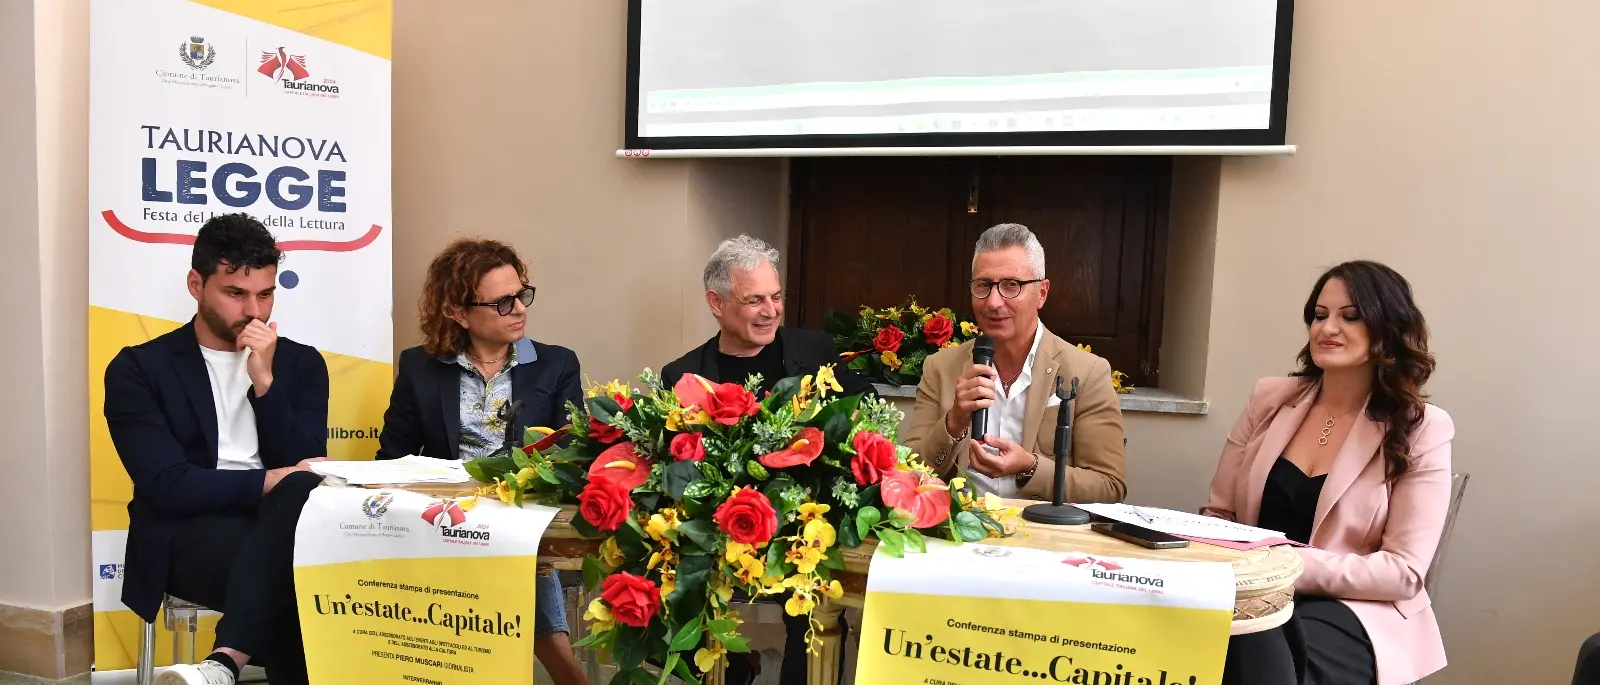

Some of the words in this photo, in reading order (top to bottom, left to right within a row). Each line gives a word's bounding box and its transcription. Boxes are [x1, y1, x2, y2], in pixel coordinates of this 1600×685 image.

[281, 78, 340, 94] Taurianova
[140, 124, 348, 163] TAURIANOVA
[140, 157, 347, 213] LEGGE
[143, 207, 178, 222] Festa
[184, 210, 204, 223] del
[263, 214, 294, 228] della
[300, 216, 345, 231] Lettura
[340, 522, 367, 530] Comune
[440, 525, 490, 541] Taurianova
[1090, 568, 1164, 588] Taurianova
[357, 579, 398, 590] Conferenza
[399, 583, 423, 593] stampa
[424, 585, 431, 594] di
[432, 587, 480, 600] presentazione
[947, 618, 1006, 636] Conferenza
[1008, 628, 1047, 642] stampa
[1050, 634, 1060, 644] di
[1062, 637, 1137, 655] presentazione
[396, 653, 413, 663] PIERO
[414, 657, 442, 669] MUSCARI
[883, 627, 1197, 685] Un'estate...Capital
